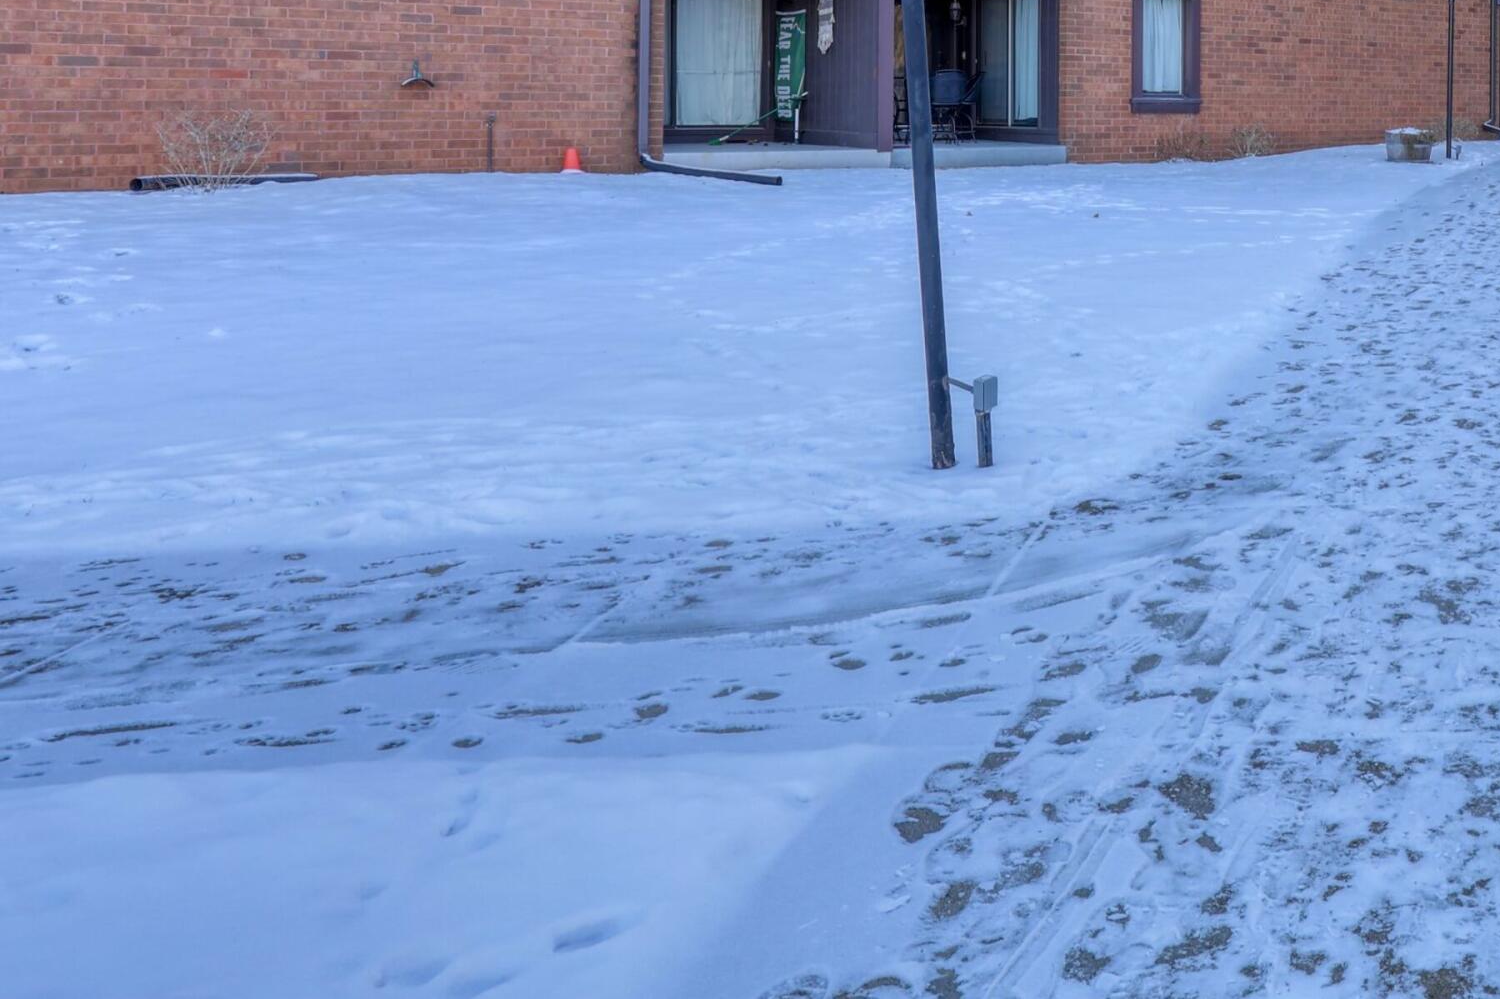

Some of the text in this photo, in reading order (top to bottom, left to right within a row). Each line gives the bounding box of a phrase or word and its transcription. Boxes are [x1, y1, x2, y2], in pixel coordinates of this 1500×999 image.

[777, 16, 795, 118] FEAR THE DEER
